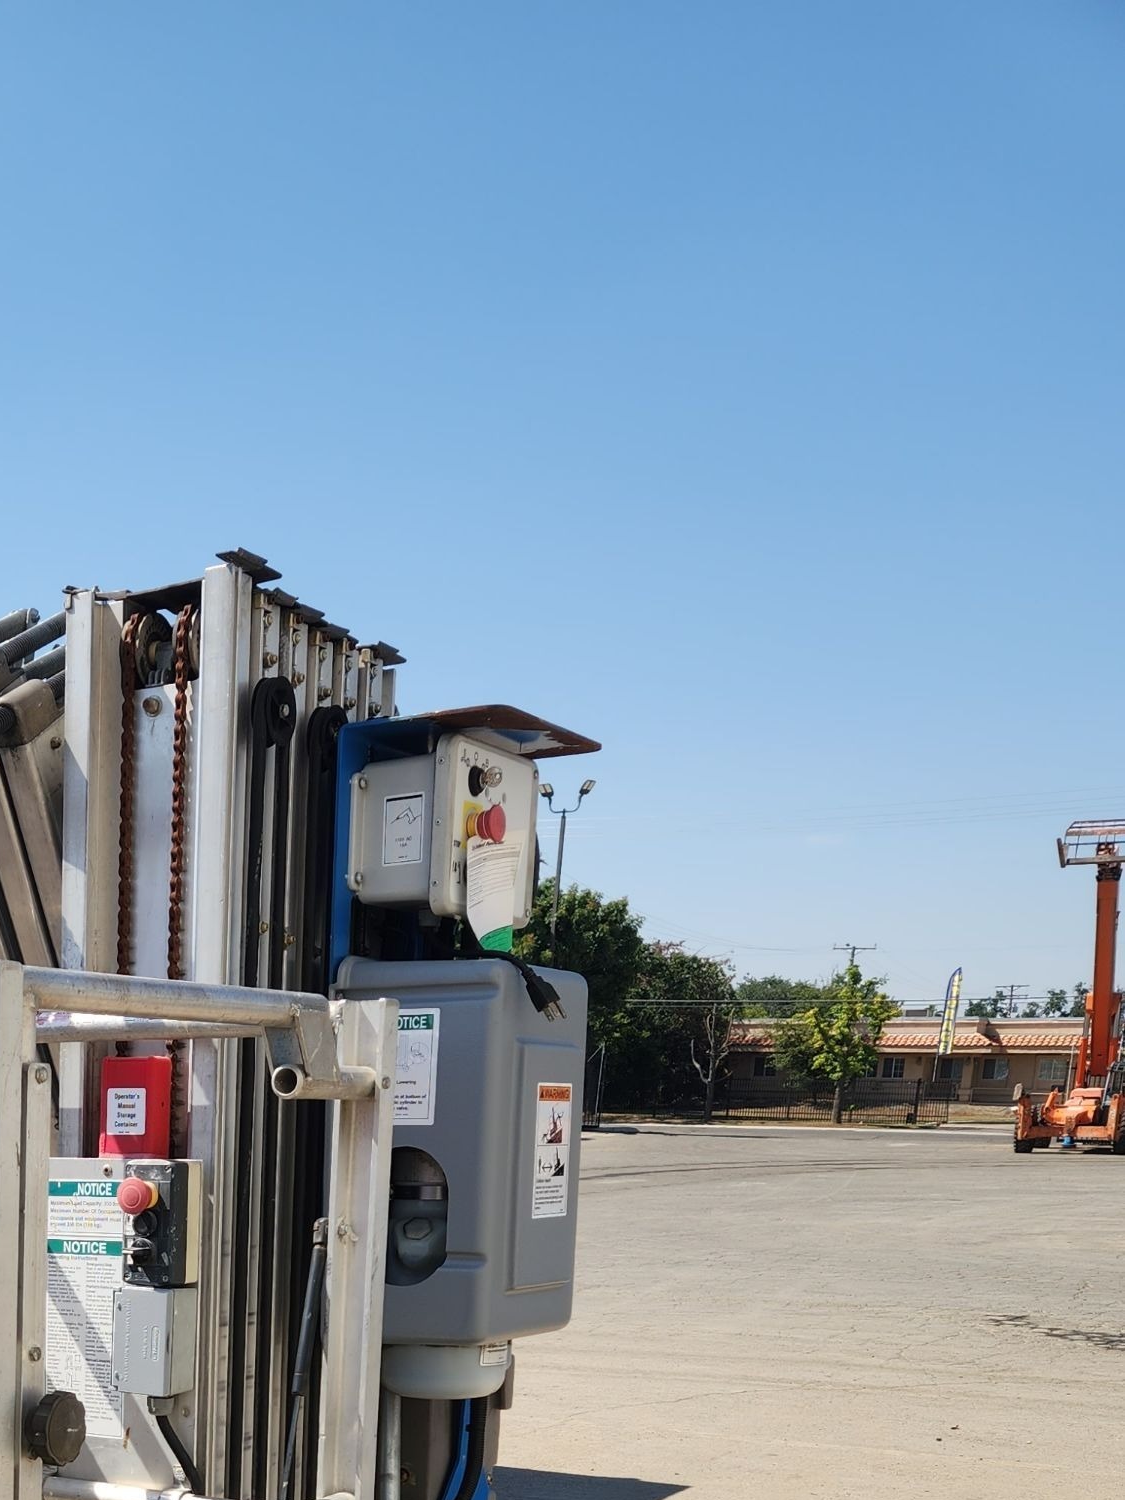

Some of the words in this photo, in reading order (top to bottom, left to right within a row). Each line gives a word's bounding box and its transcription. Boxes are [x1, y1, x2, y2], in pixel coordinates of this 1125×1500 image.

[397, 1016, 427, 1029] OTICE
[545, 1088, 569, 1099] WARNING
[77, 1182, 112, 1196] NOTICE
[63, 1241, 107, 1254] NOTICE
